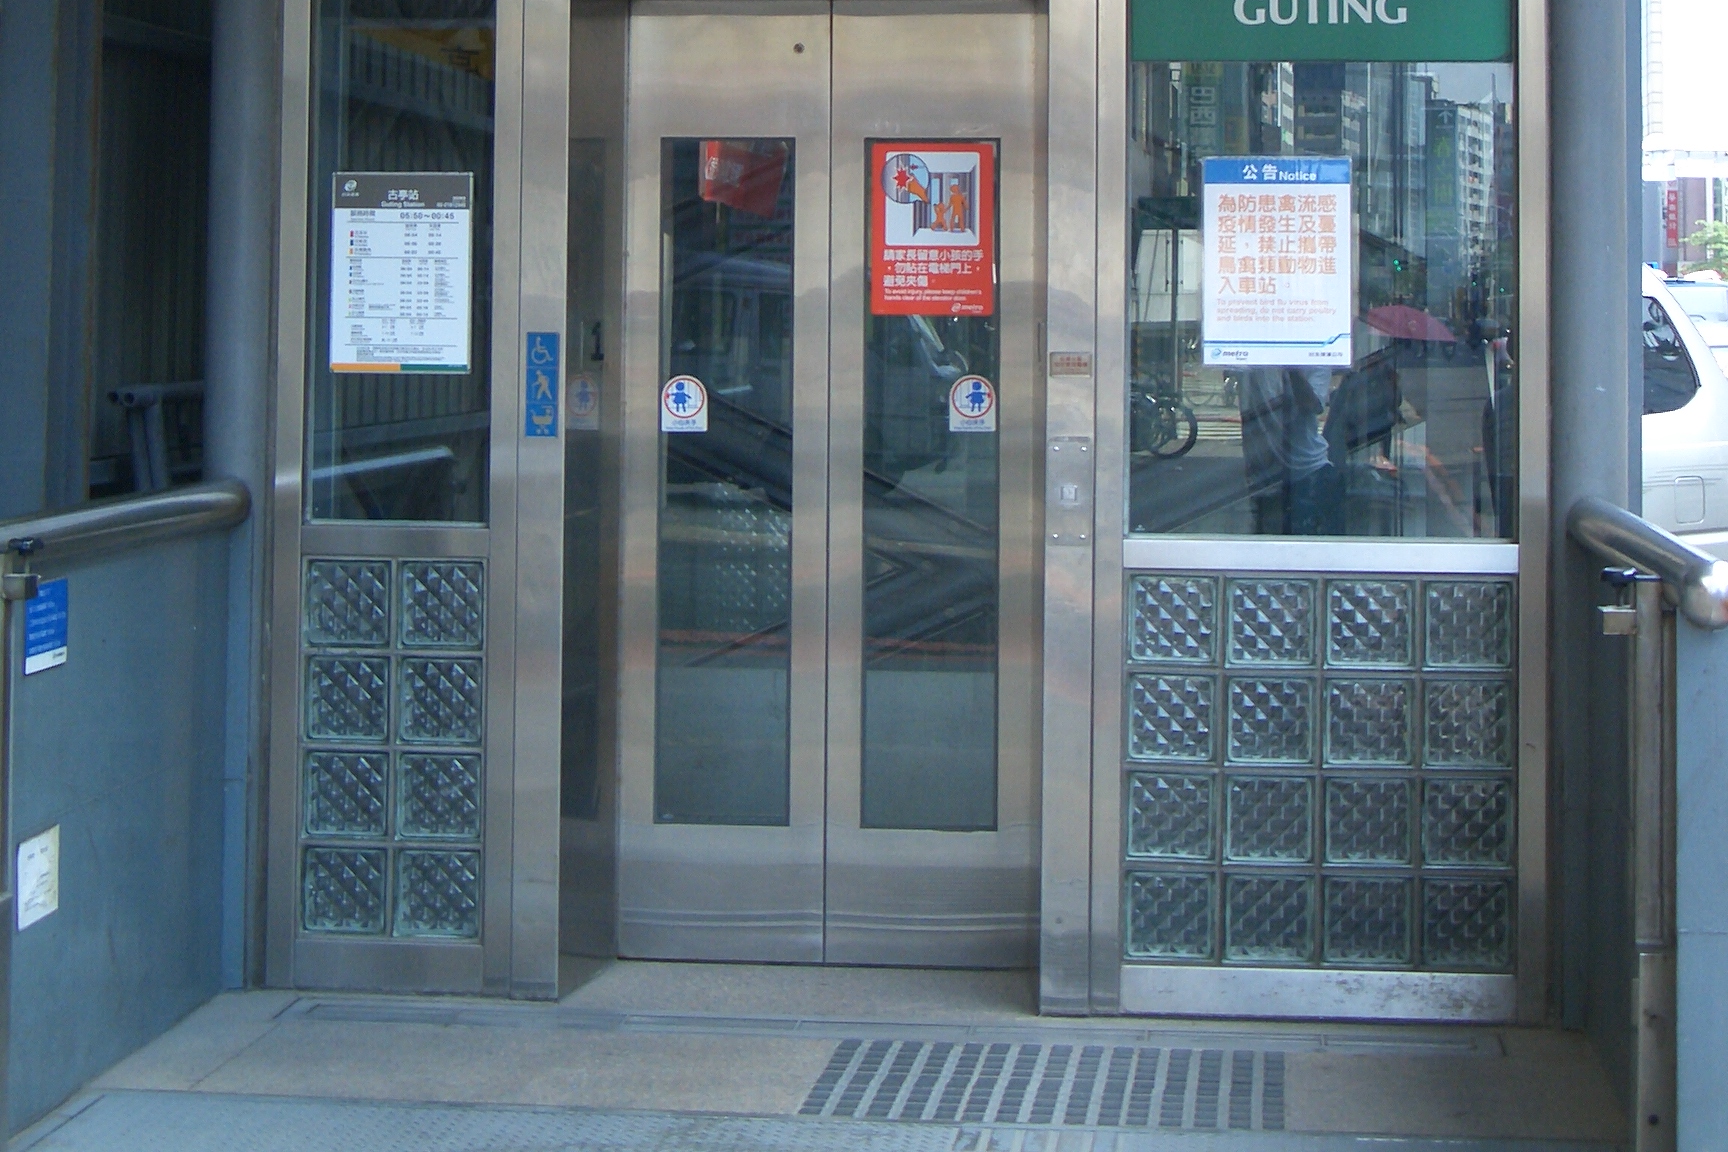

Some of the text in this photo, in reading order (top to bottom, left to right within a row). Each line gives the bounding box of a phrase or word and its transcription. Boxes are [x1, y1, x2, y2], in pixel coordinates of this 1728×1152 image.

[1242, 164, 1317, 181] 公告 Notice
[387, 189, 419, 201] 古亭站
[1217, 194, 1337, 213] 為防患禽流感
[1217, 256, 1337, 275] 鳥禽類動物進
[1308, 307, 1337, 315] poultry
